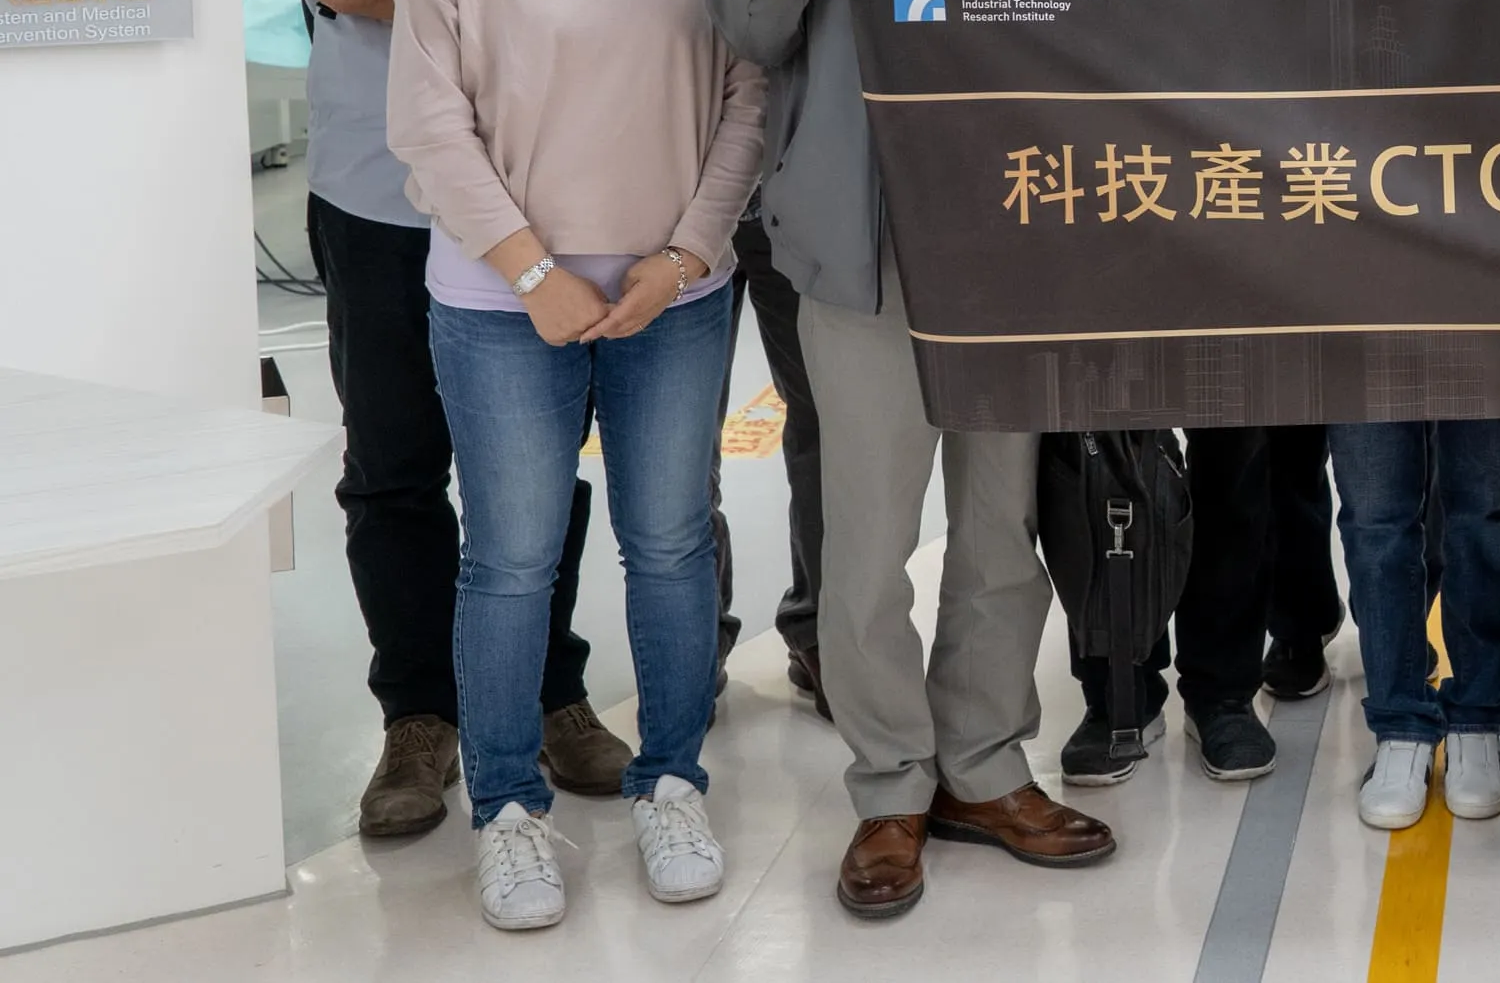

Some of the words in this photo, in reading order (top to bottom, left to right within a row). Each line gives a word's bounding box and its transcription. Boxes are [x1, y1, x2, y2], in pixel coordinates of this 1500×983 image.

[962, 0, 1011, 9] Industrial
[1014, 0, 1071, 11] Technology
[44, 10, 77, 22] and
[82, 5, 150, 22] Medical
[963, 12, 1010, 21] Research
[1012, 12, 1055, 21] Institute
[85, 24, 150, 41] System
